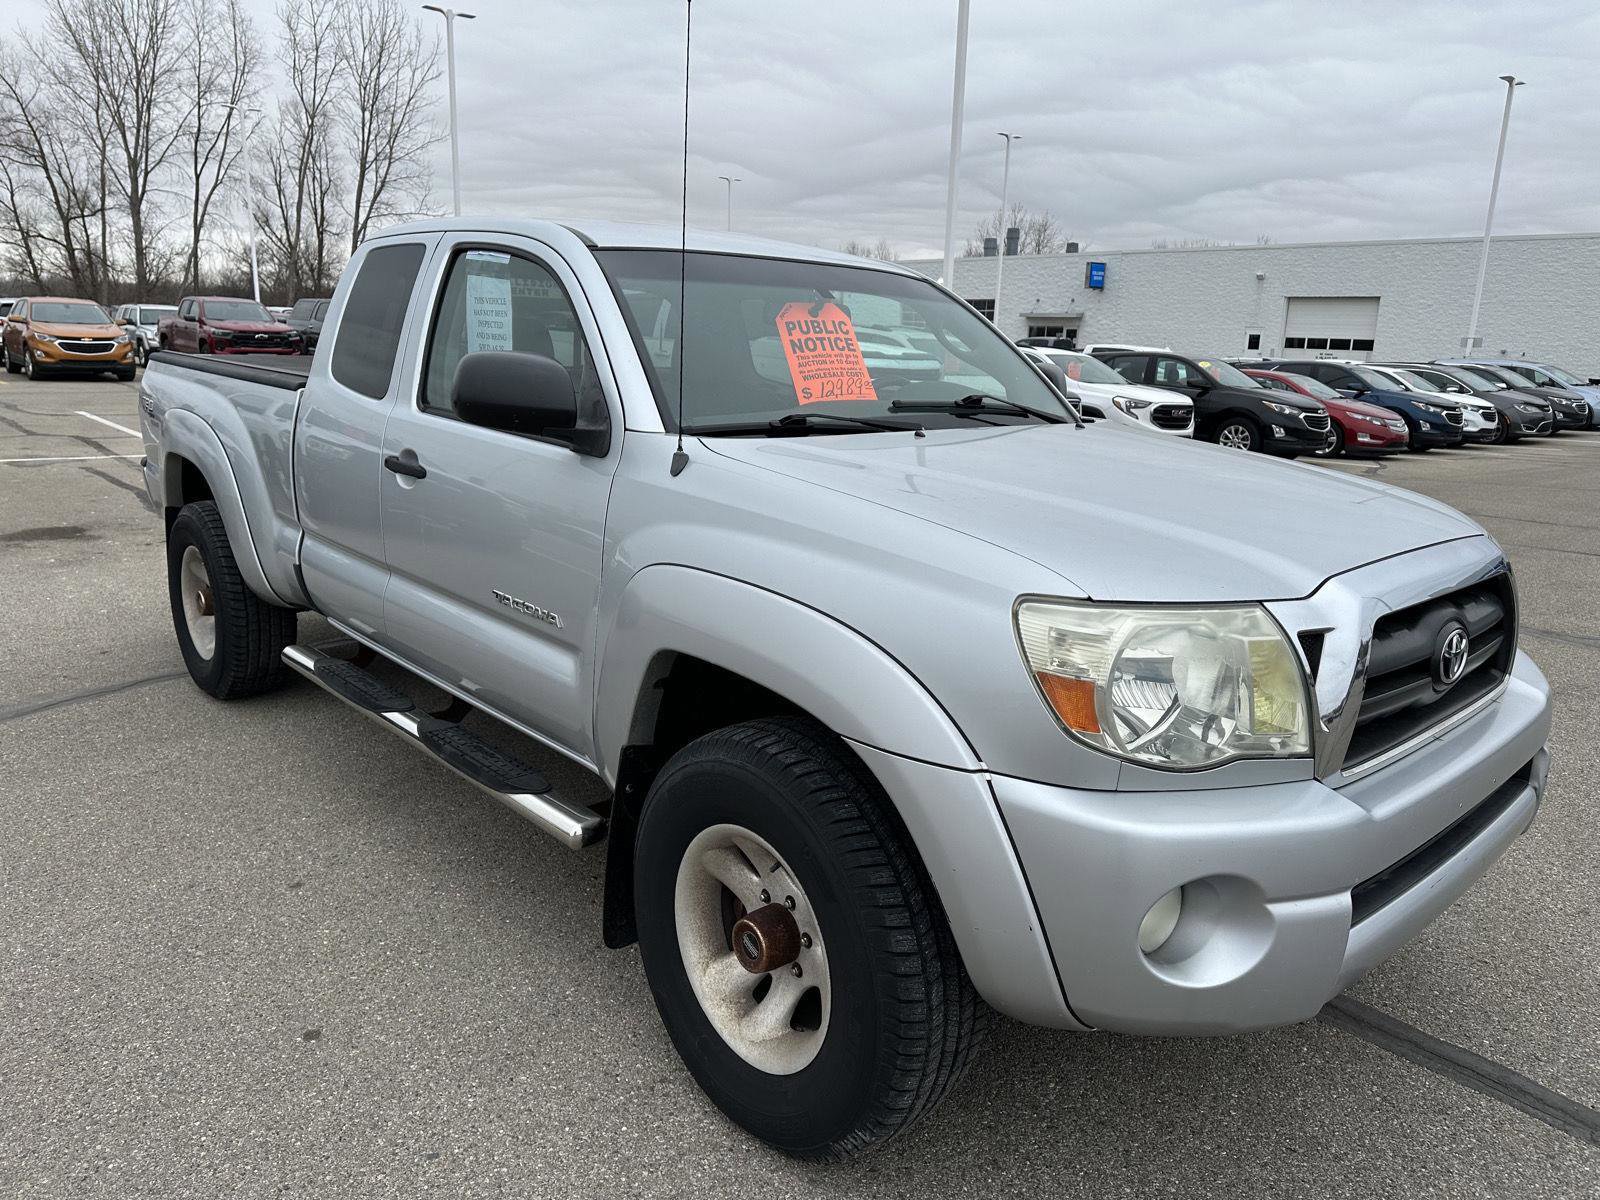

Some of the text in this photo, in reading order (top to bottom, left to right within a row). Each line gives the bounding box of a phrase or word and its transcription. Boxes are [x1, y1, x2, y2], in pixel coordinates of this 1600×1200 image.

[484, 297, 507, 306] VEHICLE
[478, 320, 504, 329] INSPECTED
[785, 320, 850, 336] PUBLIC
[476, 332, 486, 340] AND
[790, 336, 856, 354] NOTICE
[798, 359, 828, 368] AUCTION
[844, 359, 859, 367] days!
[802, 371, 845, 381] WHOLESALE
[801, 386, 813, 400] $
[492, 589, 564, 629] TACOMA
